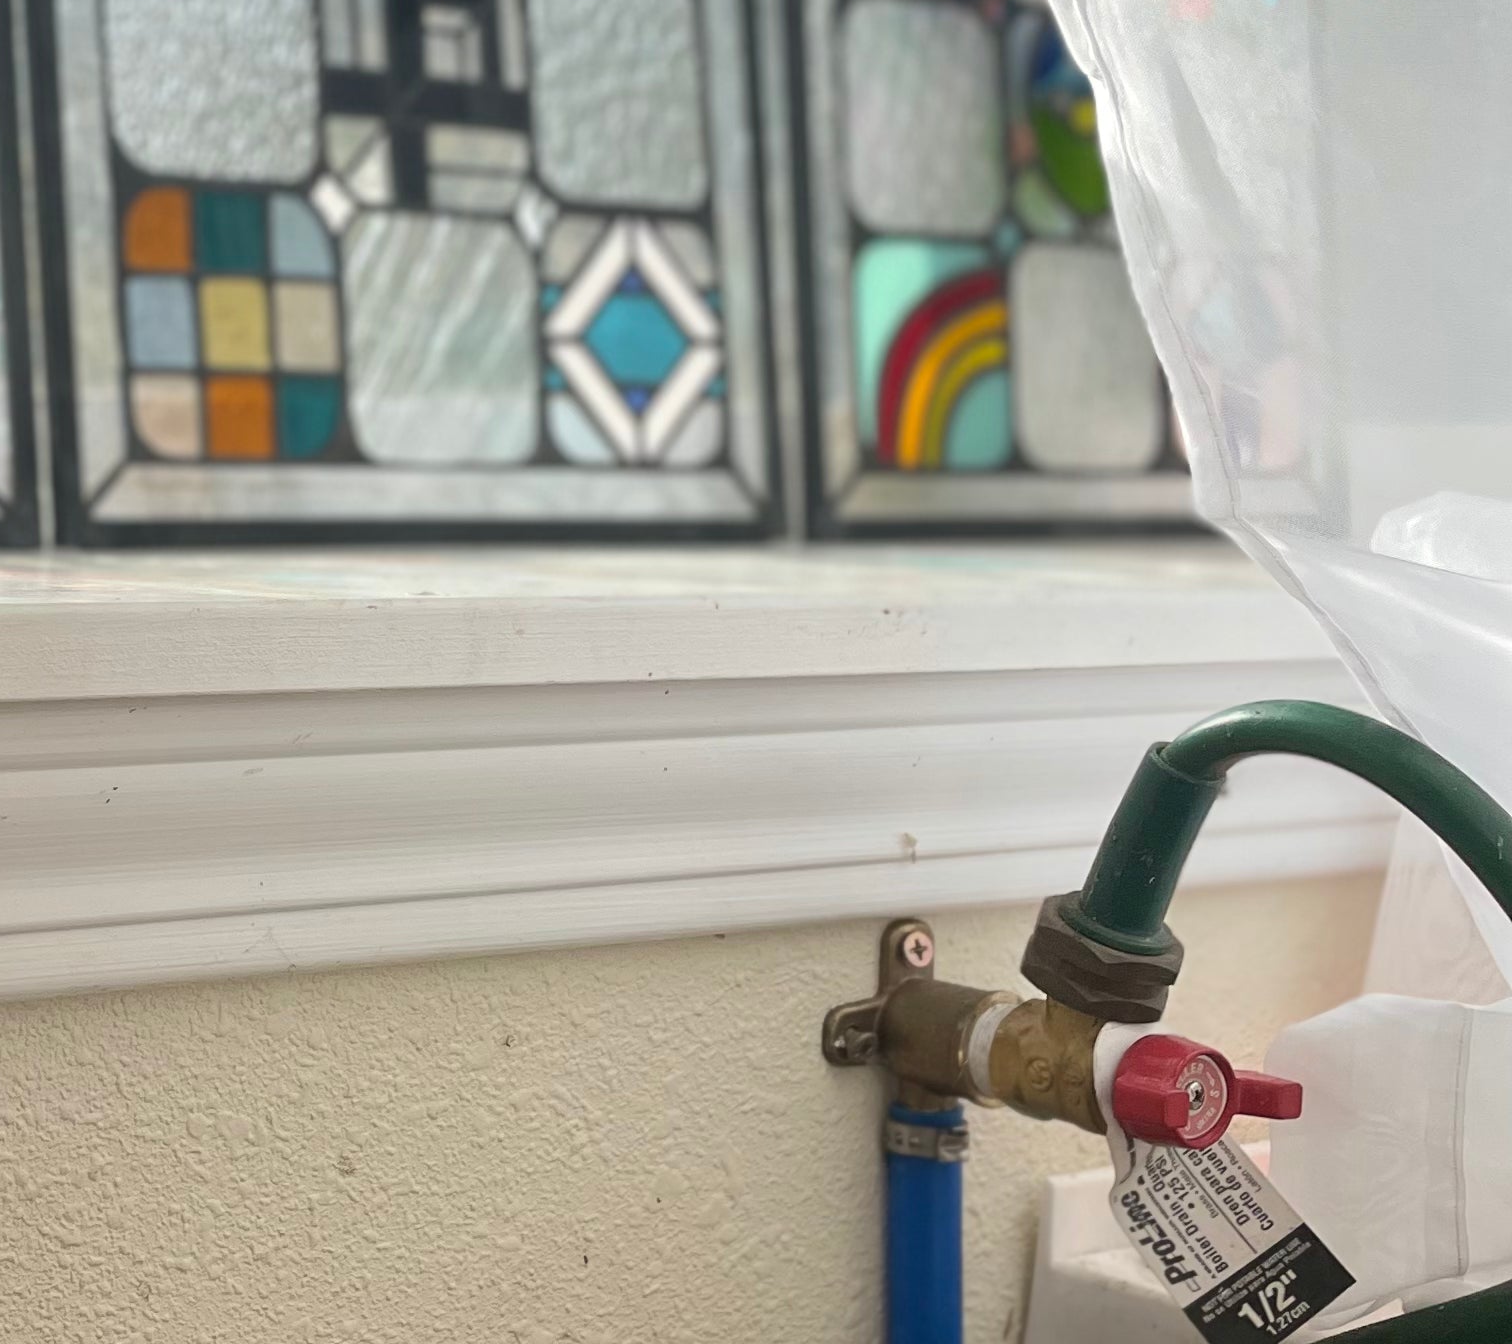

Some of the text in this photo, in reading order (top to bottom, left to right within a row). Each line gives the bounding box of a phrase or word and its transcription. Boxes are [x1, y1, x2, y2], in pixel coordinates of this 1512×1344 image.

[1155, 1154, 1190, 1202] 125 PSI
[1201, 1147, 1227, 1175] vuel
[1182, 1148, 1251, 1226] Dren para cal
[1225, 1175, 1243, 1191] de
[1170, 1201, 1199, 1236] Drain
[1239, 1191, 1274, 1231] Cuarto
[1121, 1190, 1197, 1284] ProLine
[1195, 1236, 1229, 1274] Boiler
[1238, 1269, 1297, 1329] 1/2"
[1265, 1301, 1311, 1336] 1.27cm
